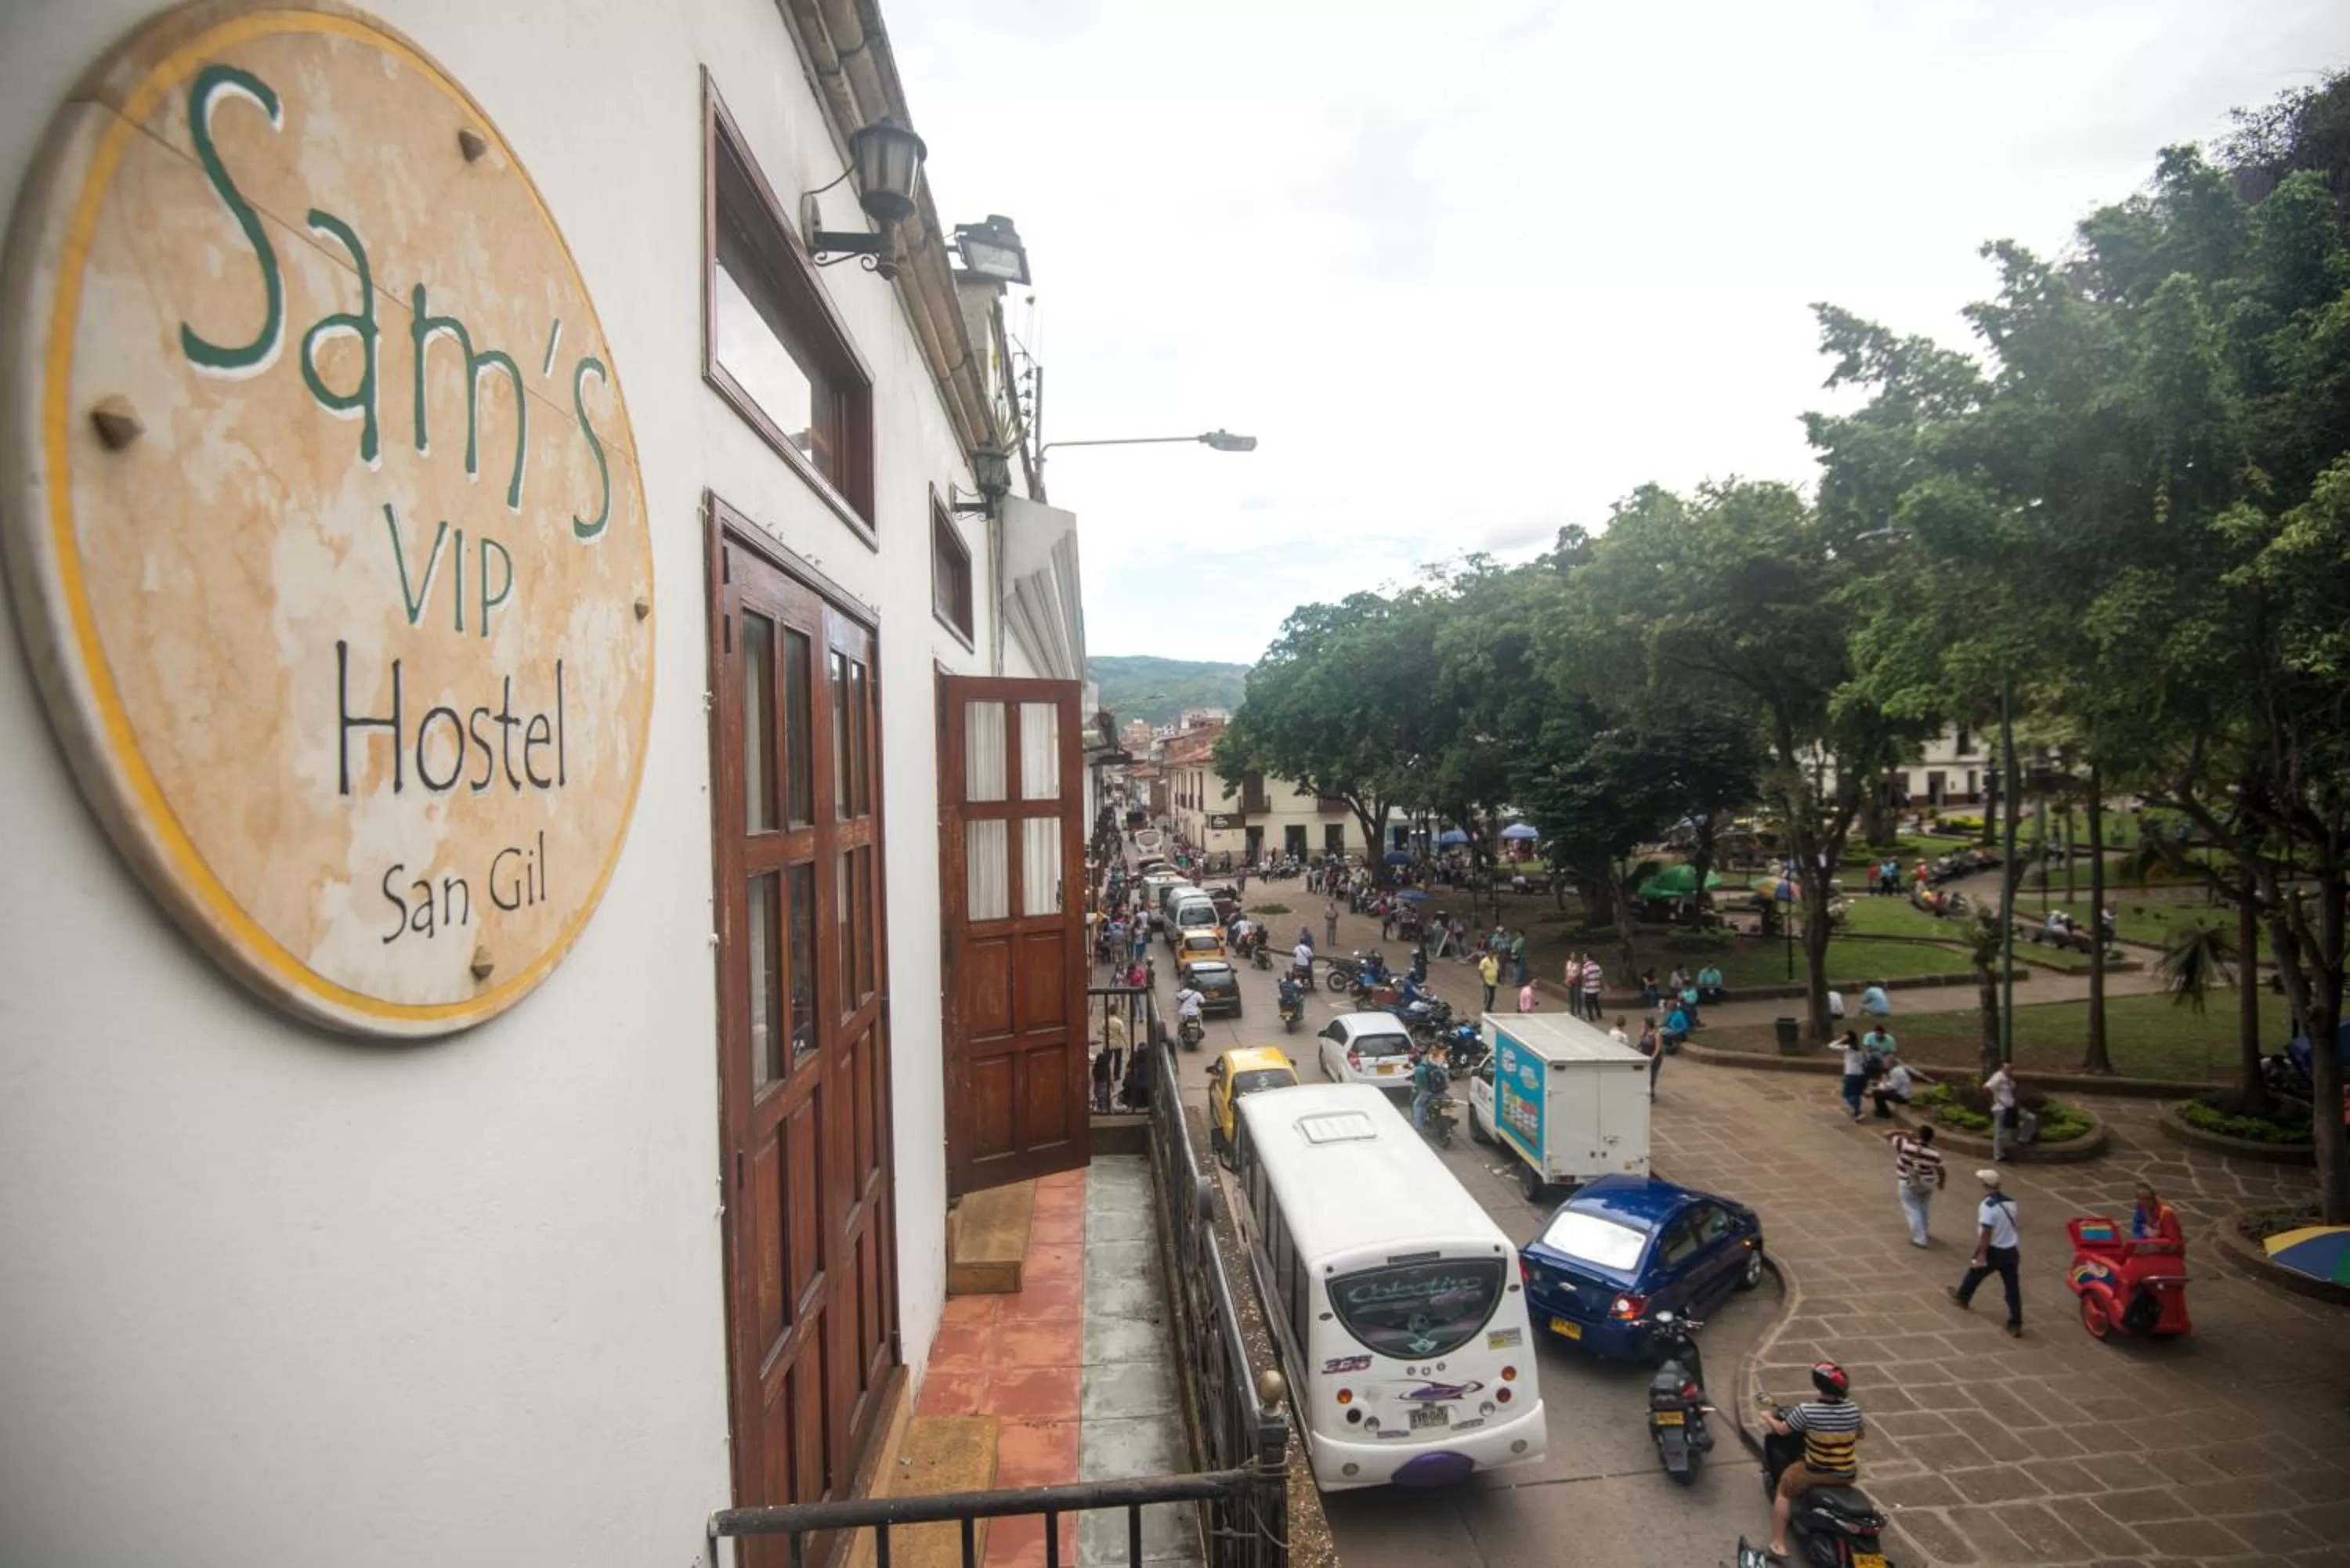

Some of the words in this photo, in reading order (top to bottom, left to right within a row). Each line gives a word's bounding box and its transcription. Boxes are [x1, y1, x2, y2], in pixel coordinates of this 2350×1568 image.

[181, 63, 609, 540] Sam's
[382, 502, 515, 637] VIP
[336, 639, 566, 795] Hostel
[382, 863, 469, 944] San
[490, 829, 546, 911] Gil
